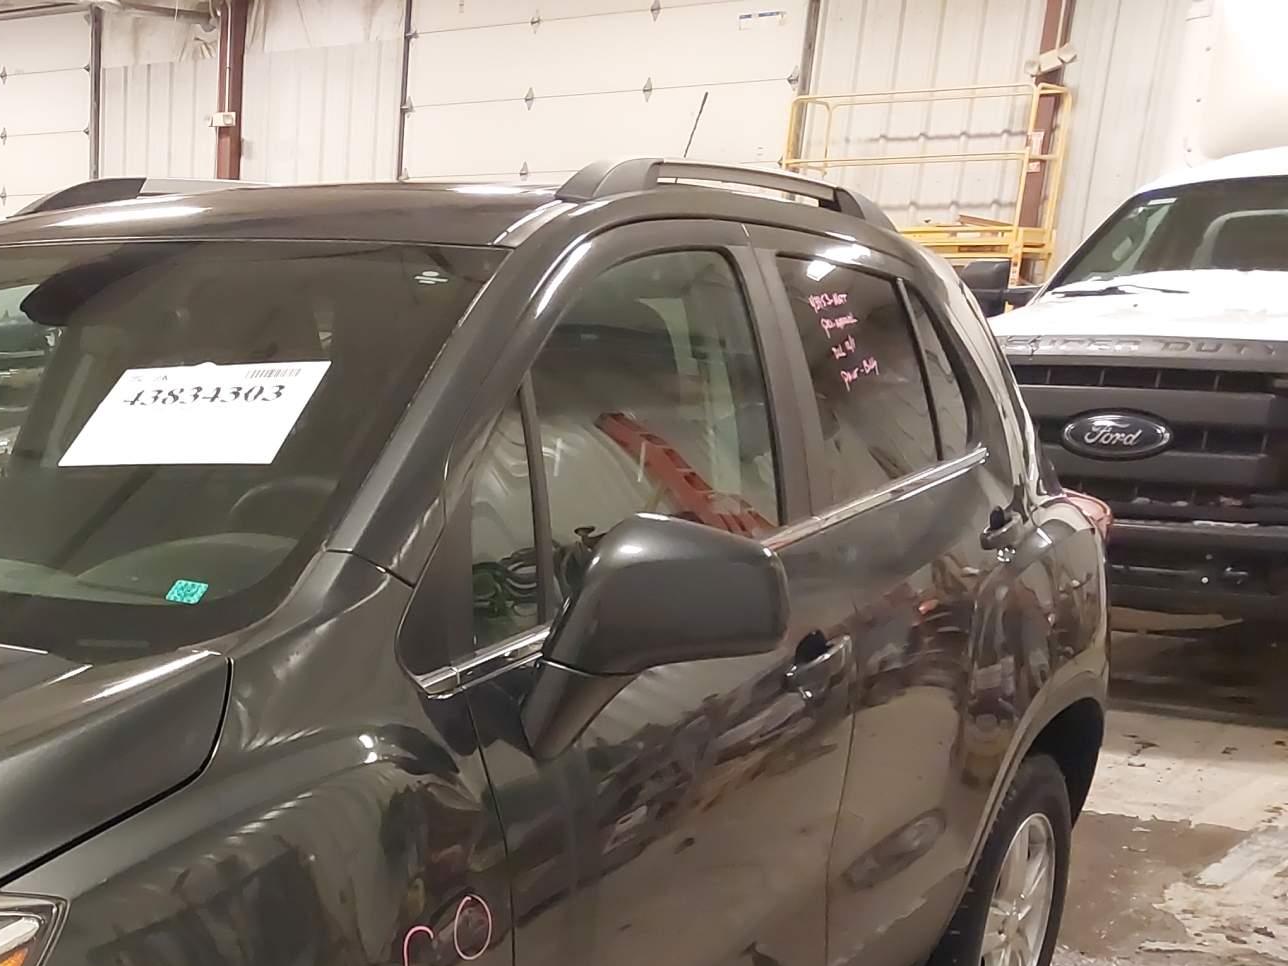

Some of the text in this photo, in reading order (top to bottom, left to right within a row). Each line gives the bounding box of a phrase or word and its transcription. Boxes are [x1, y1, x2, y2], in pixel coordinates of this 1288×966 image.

[1152, 338, 1281, 356] DUTY
[123, 384, 286, 407] 43834303
[1083, 419, 1143, 447] Ford
